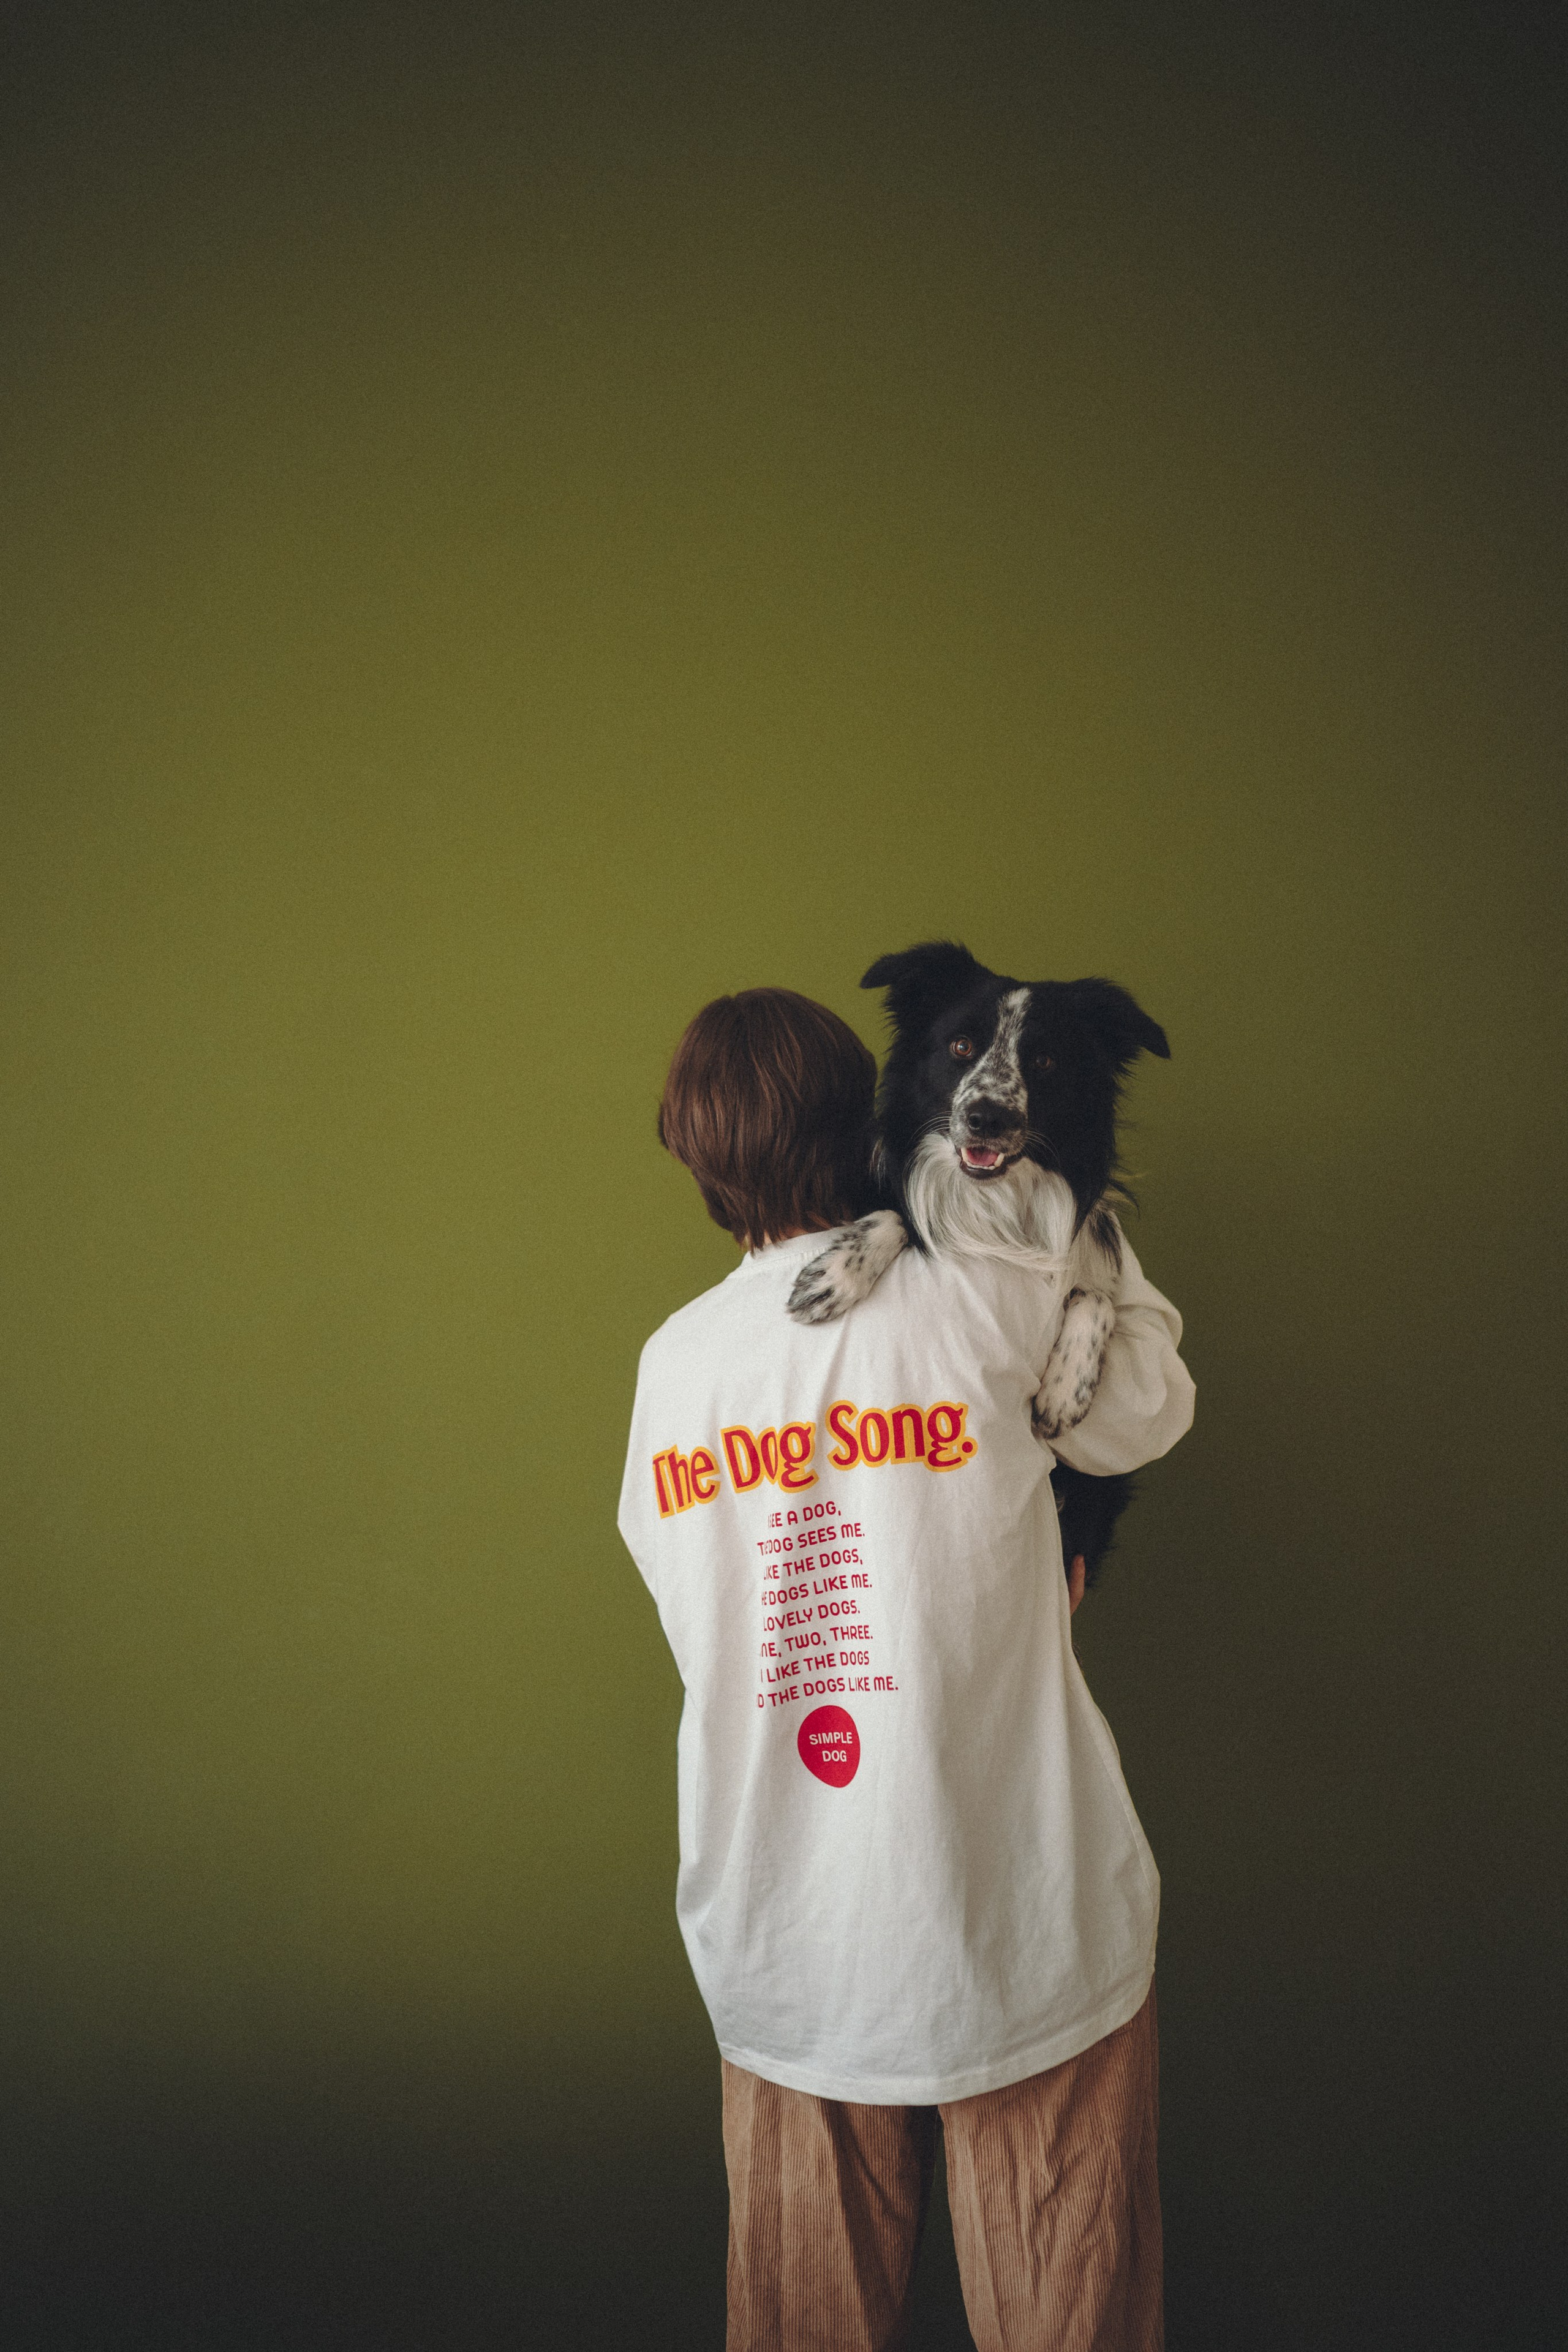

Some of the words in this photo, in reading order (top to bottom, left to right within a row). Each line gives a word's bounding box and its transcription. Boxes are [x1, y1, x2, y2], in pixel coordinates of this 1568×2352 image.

[652, 1444, 721, 1518] The
[721, 1422, 820, 1493] Dog
[824, 1400, 978, 1472] Song.
[787, 1510, 799, 1526] A
[802, 1501, 842, 1521] DOG,
[797, 1526, 837, 1548] SEES
[840, 1523, 865, 1539] ME.
[782, 1556, 816, 1577] THE
[819, 1548, 863, 1568] DOGS,
[768, 1583, 809, 1605] DOGS
[813, 1575, 849, 1595] LIKE
[851, 1574, 873, 1588] ME.
[763, 1608, 813, 1632] LOVELY
[817, 1600, 861, 1619] DOGS.
[784, 1632, 827, 1652] TWO,
[829, 1625, 873, 1642] THREE.
[766, 1660, 801, 1683] LIKE
[803, 1653, 837, 1672] THE
[840, 1651, 870, 1666] DOGS
[767, 1686, 800, 1707] THE
[803, 1677, 846, 1697] DOGS
[848, 1676, 870, 1692] LIKE
[873, 1676, 899, 1692] ME.
[809, 1732, 853, 1746] SIMPLE
[822, 1750, 847, 1763] DOG
